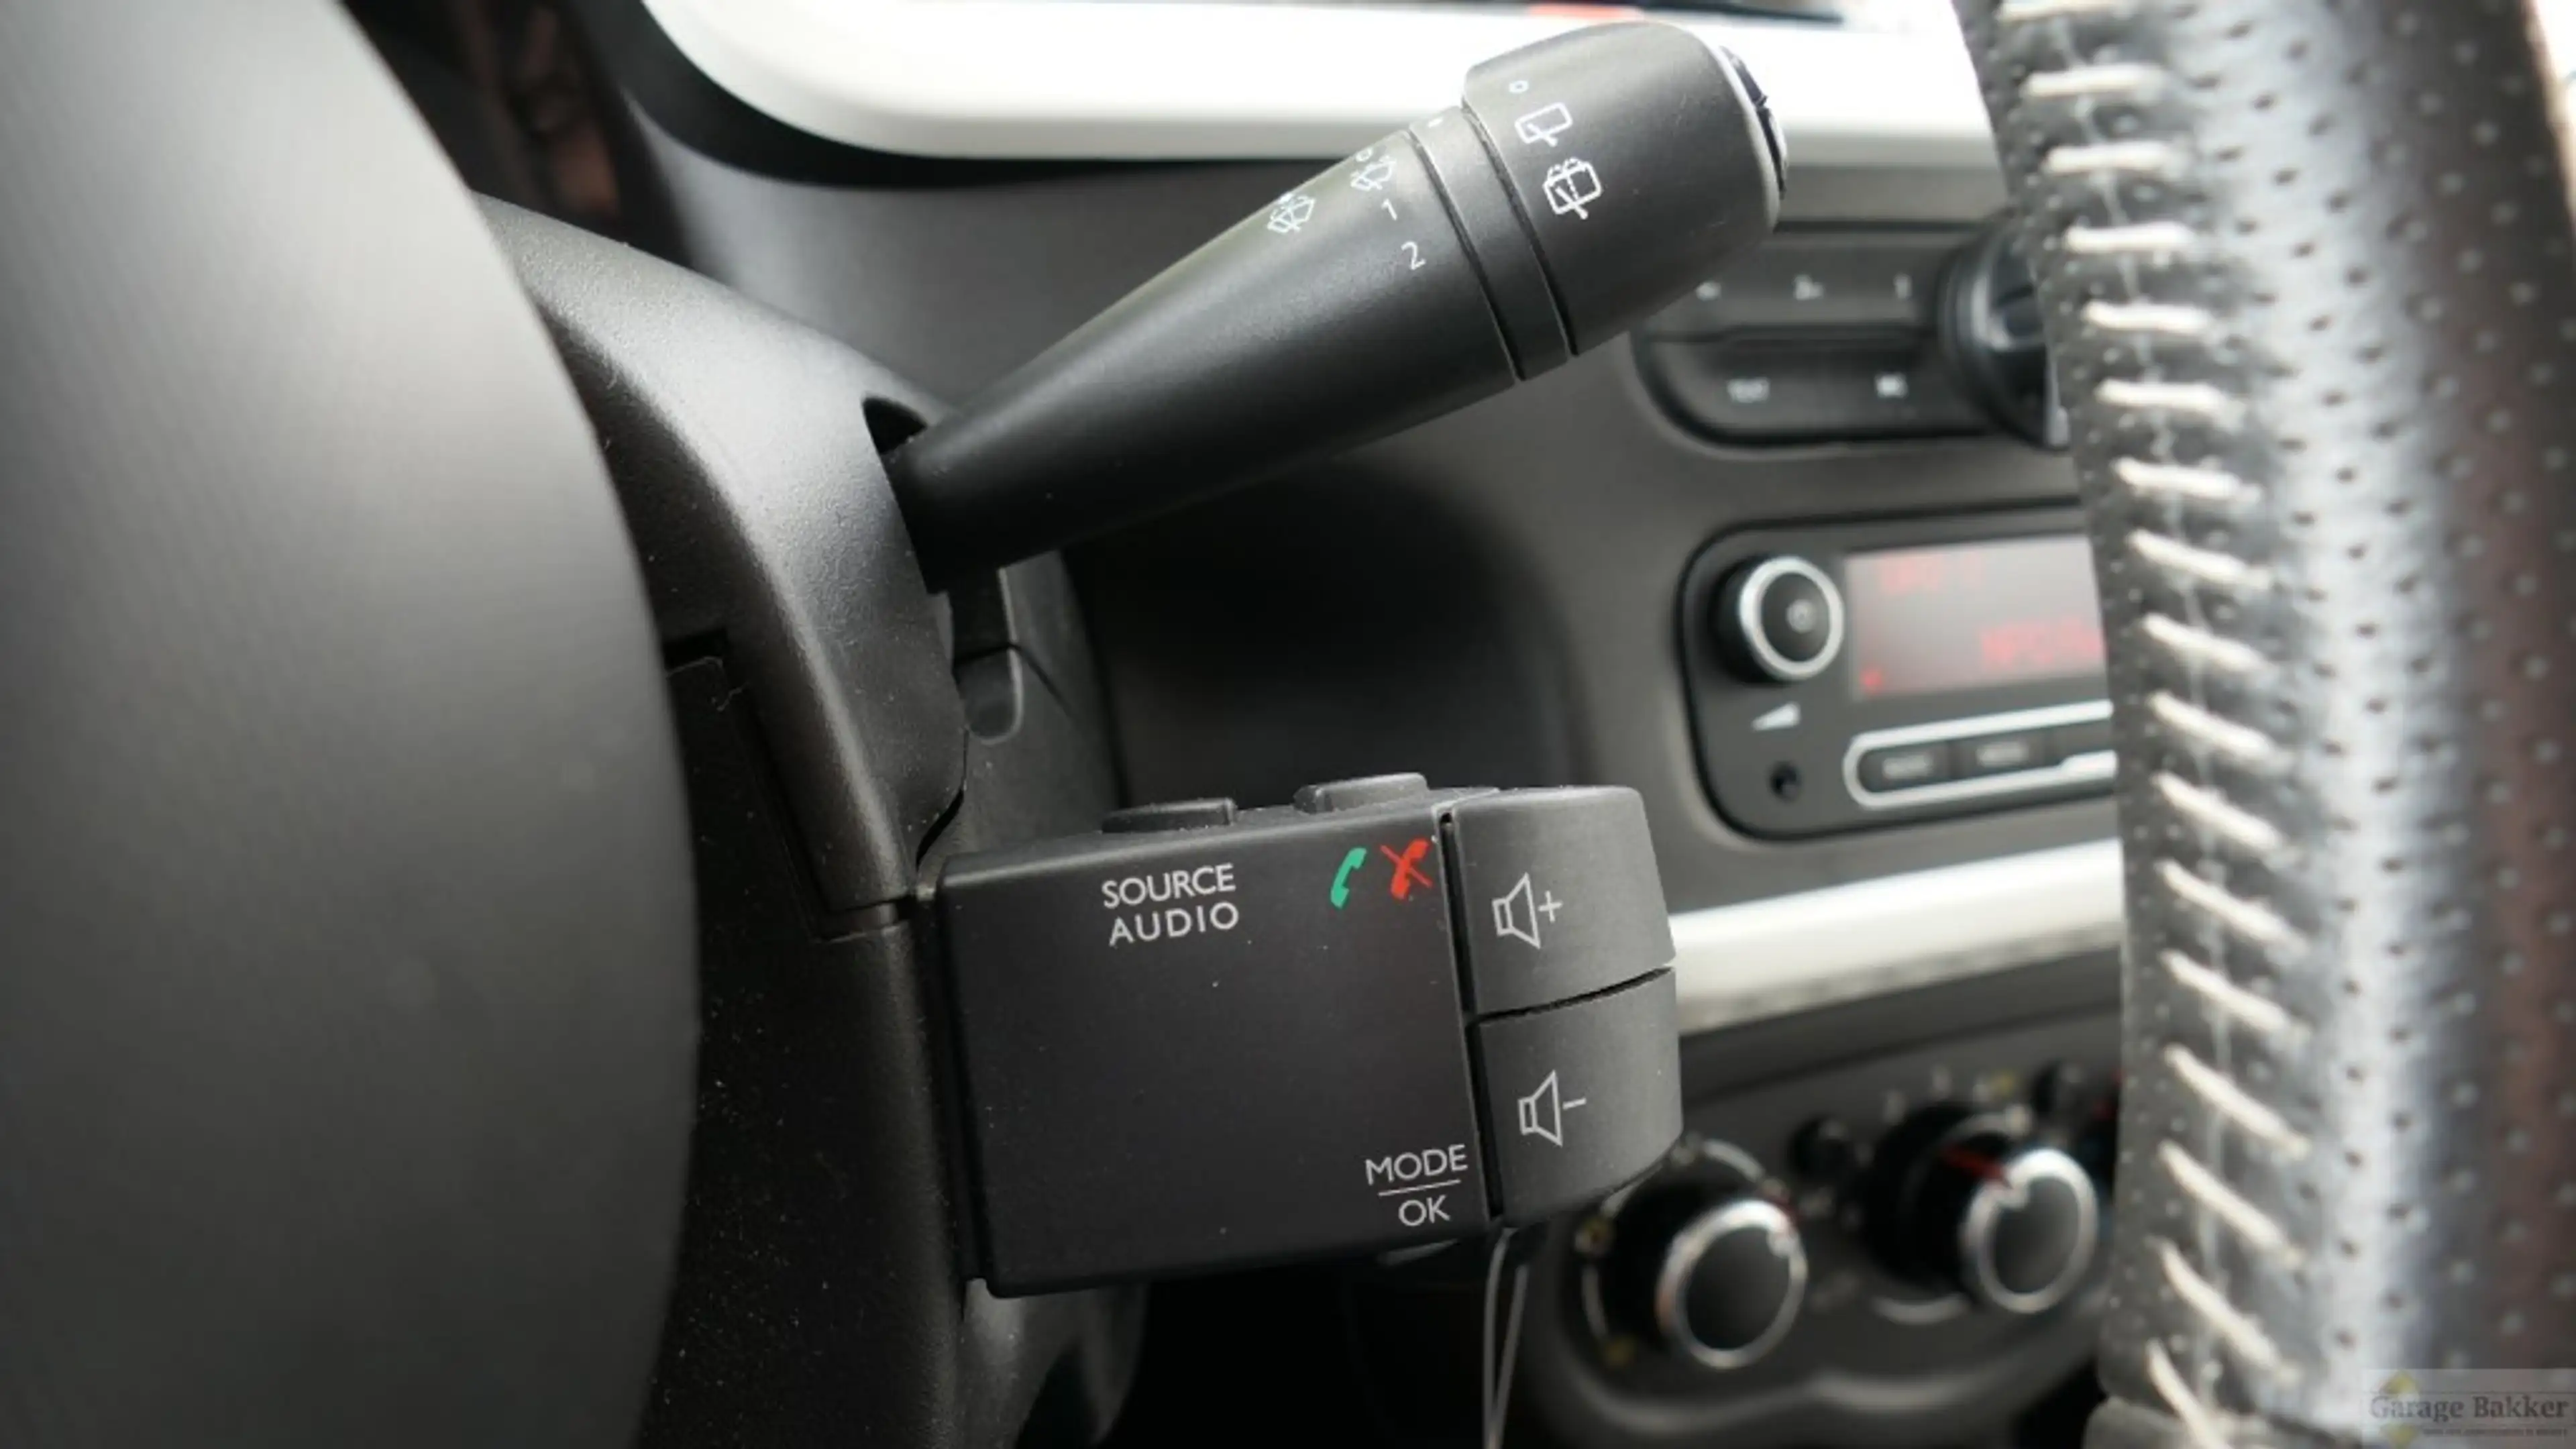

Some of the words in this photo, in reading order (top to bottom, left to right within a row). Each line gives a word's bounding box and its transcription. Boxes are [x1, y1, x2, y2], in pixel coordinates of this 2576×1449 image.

[1382, 199, 1397, 221] 1
[1401, 241, 1426, 270] 2
[1102, 863, 1236, 909] SOURCE
[1109, 901, 1239, 947] AUDIO
[1365, 1143, 1468, 1185] MODE
[1398, 1194, 1450, 1226] OK
